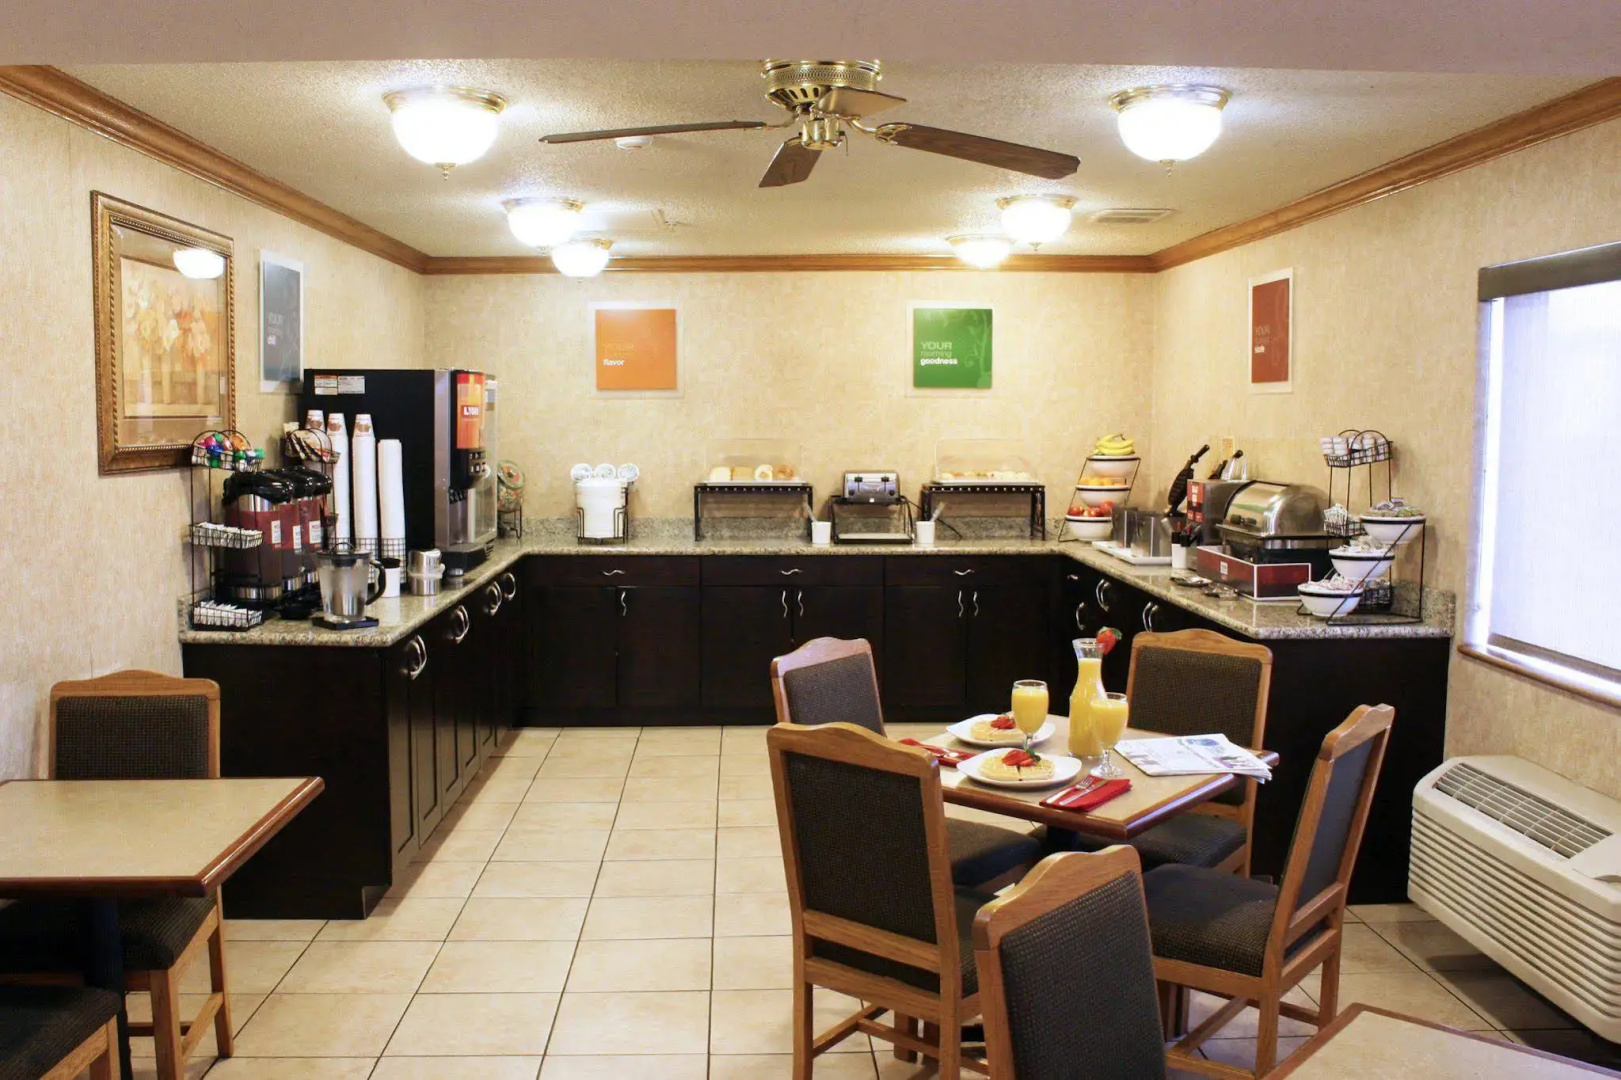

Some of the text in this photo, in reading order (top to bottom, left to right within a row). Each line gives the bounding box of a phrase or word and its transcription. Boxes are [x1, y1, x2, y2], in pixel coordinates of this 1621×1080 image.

[920, 341, 953, 350] YOUR
[603, 358, 625, 366] flavor
[920, 357, 958, 366] goodness
